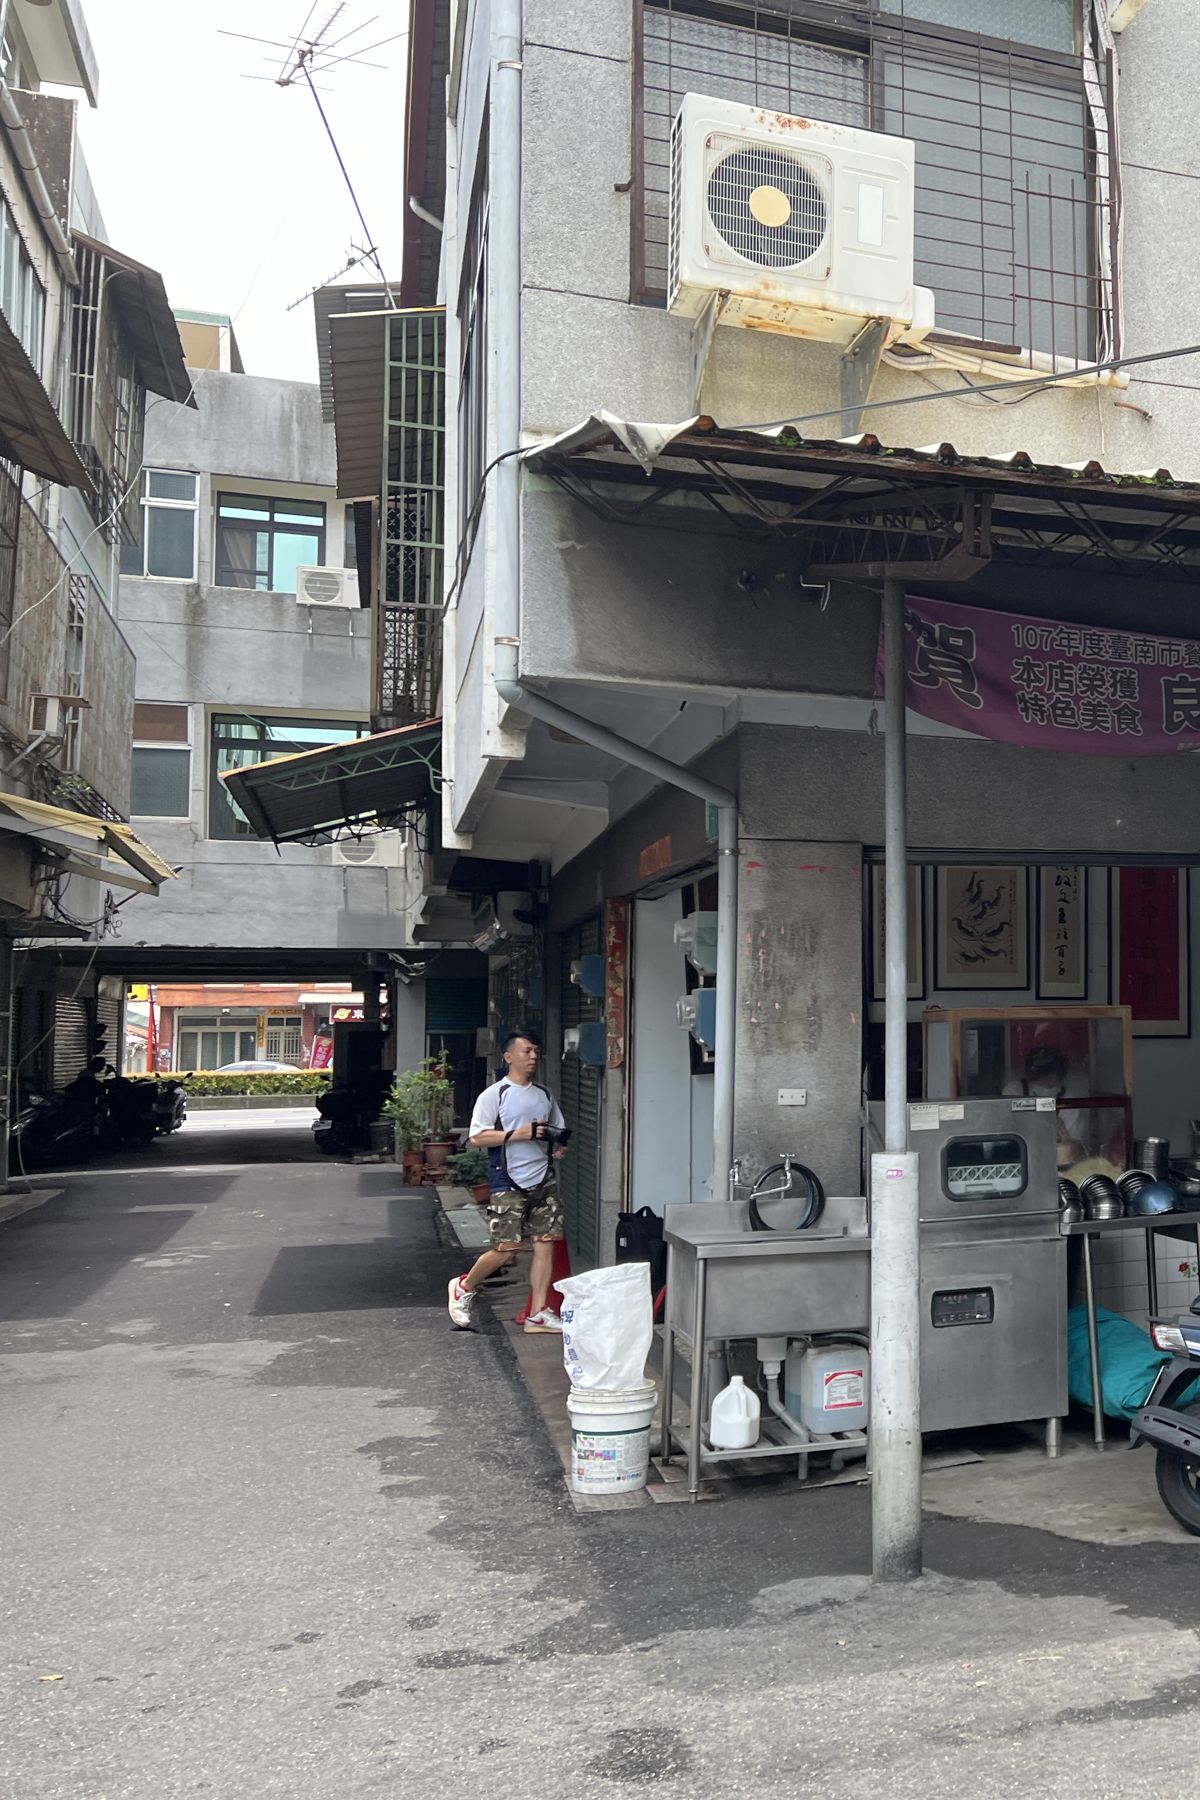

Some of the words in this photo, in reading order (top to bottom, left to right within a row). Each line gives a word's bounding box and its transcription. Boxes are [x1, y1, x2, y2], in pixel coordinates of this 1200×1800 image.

[1011, 656, 1140, 702] 本店榮獲
[1016, 692, 1144, 736] 特色美食
